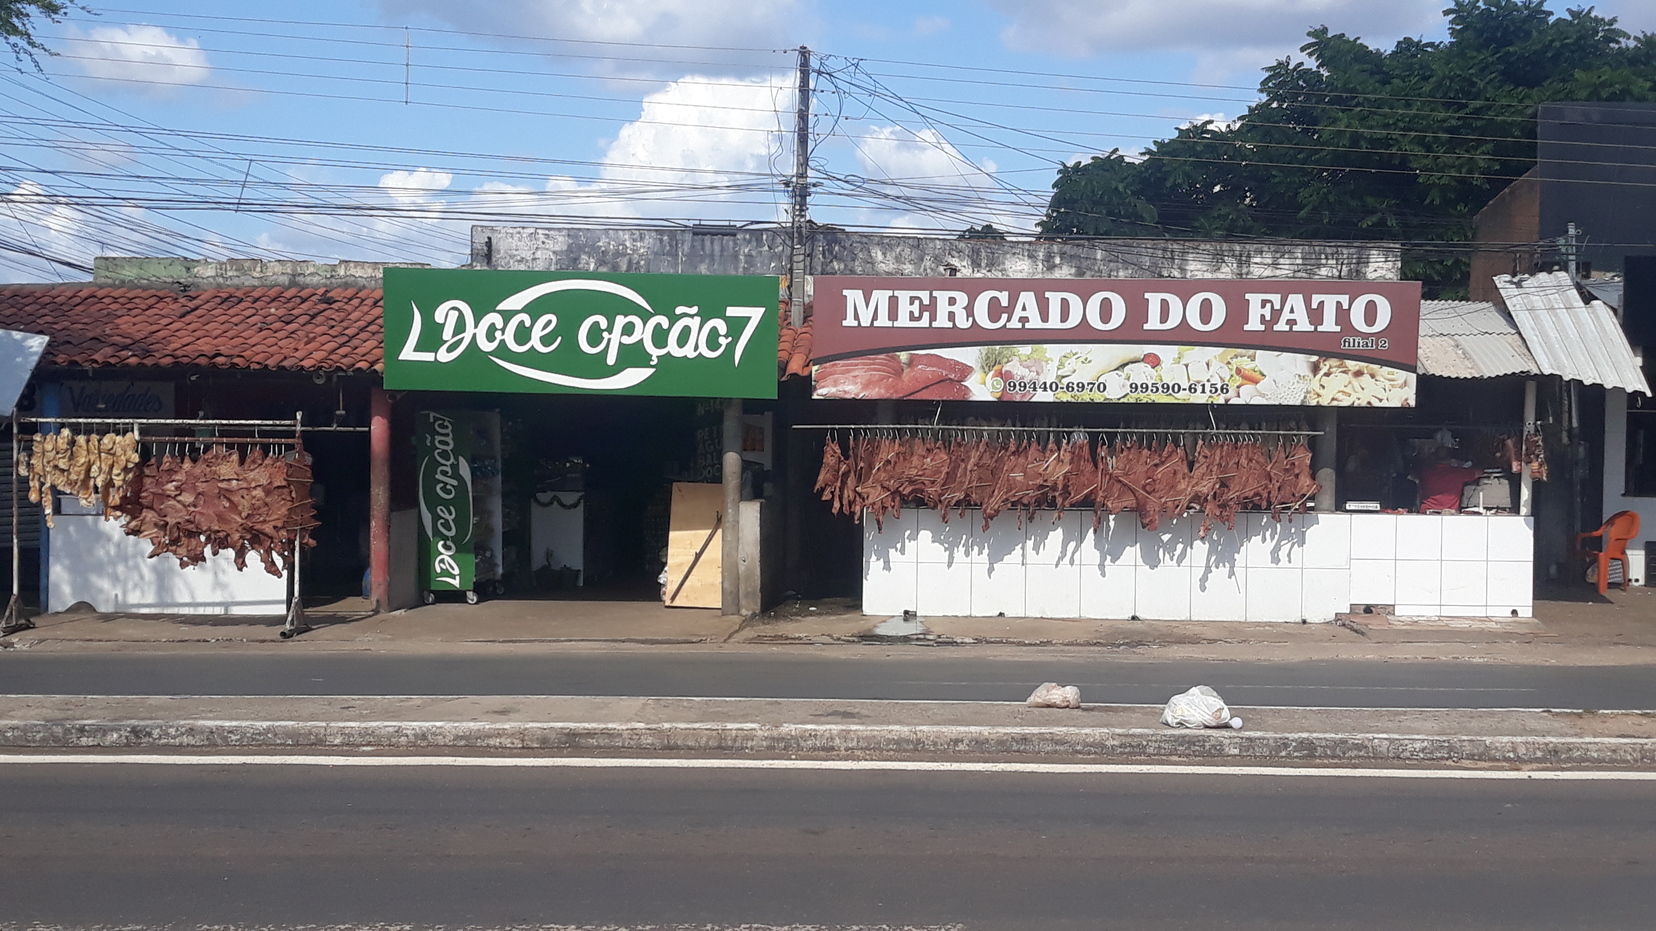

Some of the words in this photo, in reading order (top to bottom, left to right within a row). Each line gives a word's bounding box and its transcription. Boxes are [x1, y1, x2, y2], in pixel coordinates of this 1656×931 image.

[842, 289, 1126, 331] MERCADO
[1142, 291, 1227, 332] DO
[1243, 293, 1392, 334] FATO
[1341, 337, 1375, 349] filial
[1378, 338, 1389, 350] 2
[1007, 380, 1107, 393] 99440-6970
[1129, 382, 1230, 395] 99590-6156
